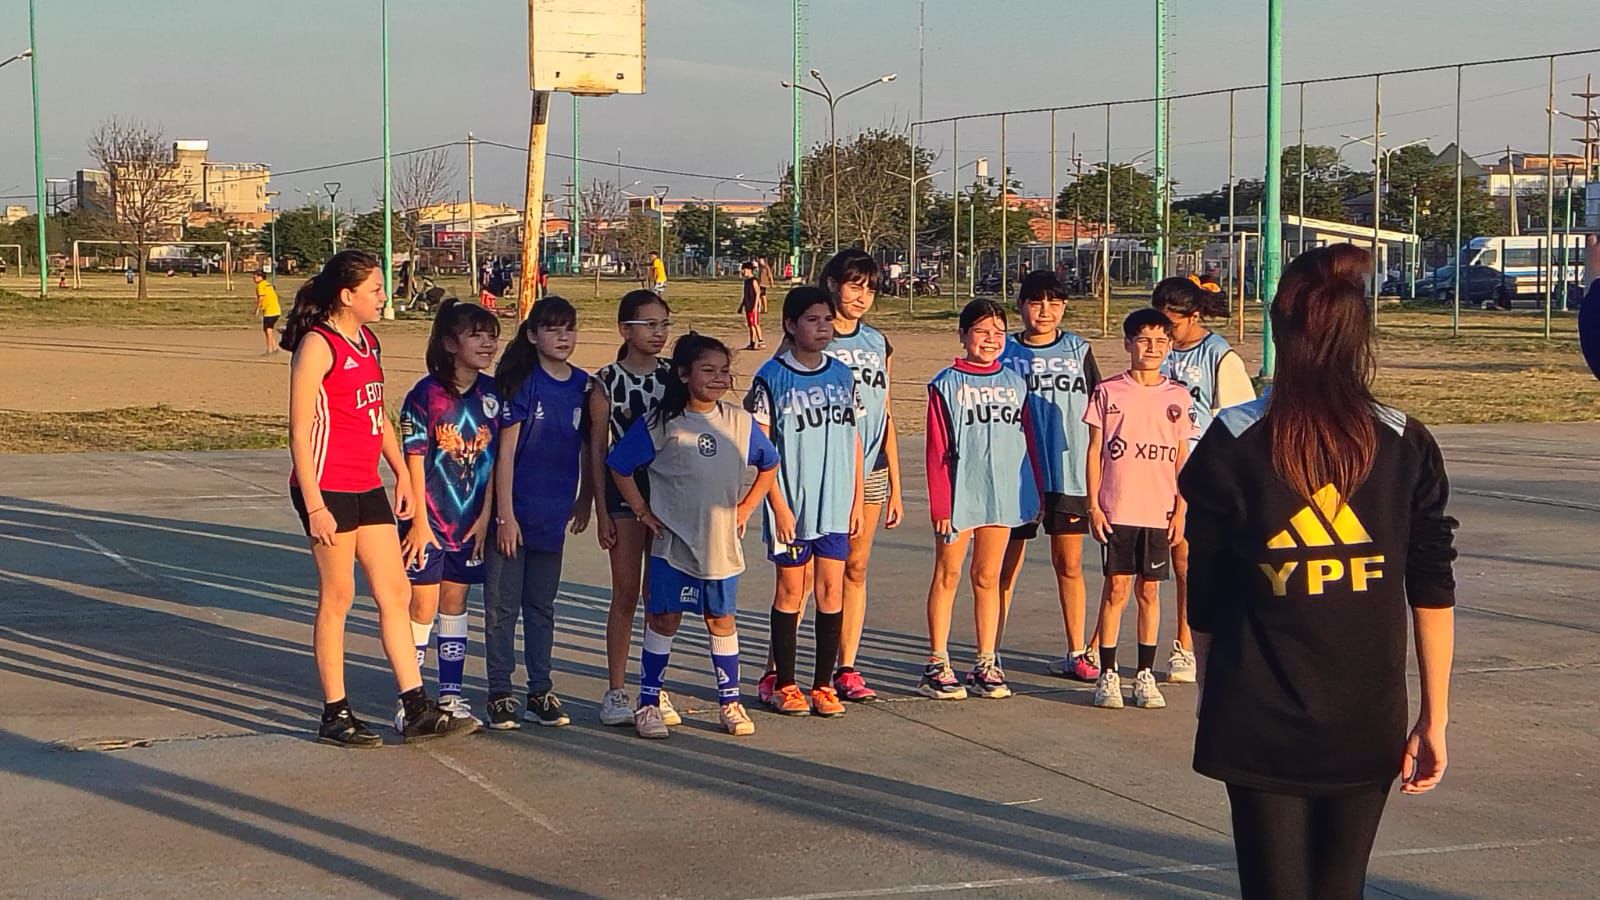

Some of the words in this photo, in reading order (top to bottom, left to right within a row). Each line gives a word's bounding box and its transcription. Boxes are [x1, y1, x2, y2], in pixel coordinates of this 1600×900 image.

[1024, 373, 1087, 395] UEGA
[368, 406, 385, 436] 14
[1134, 442, 1177, 463] XBTO
[1258, 555, 1385, 597] YPF
